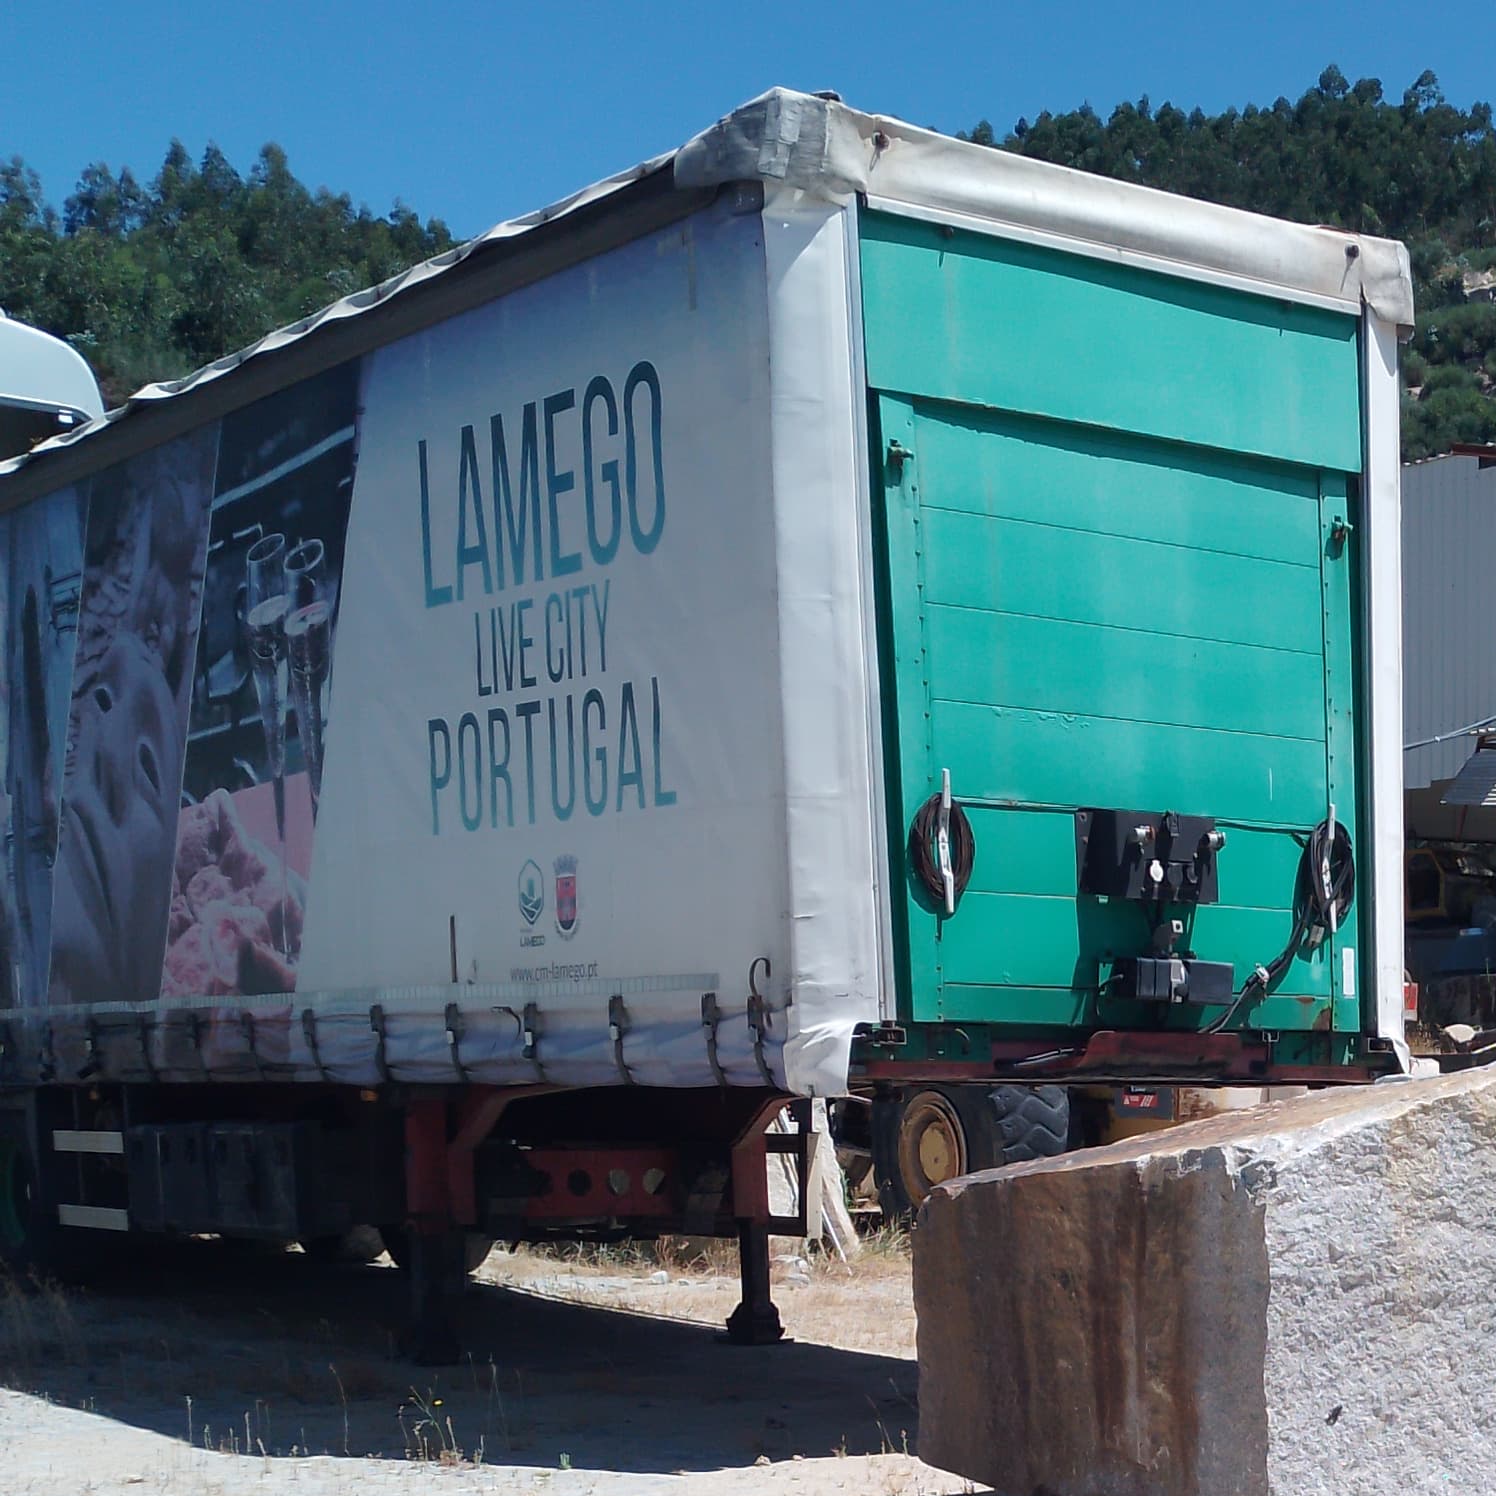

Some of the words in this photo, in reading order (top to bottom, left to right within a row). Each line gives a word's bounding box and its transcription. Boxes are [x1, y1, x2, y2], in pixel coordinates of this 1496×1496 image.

[418, 360, 666, 609] LAMEGO
[474, 599, 537, 698] LIVE
[544, 579, 611, 684] CITY
[427, 676, 678, 836] PORTUGAL
